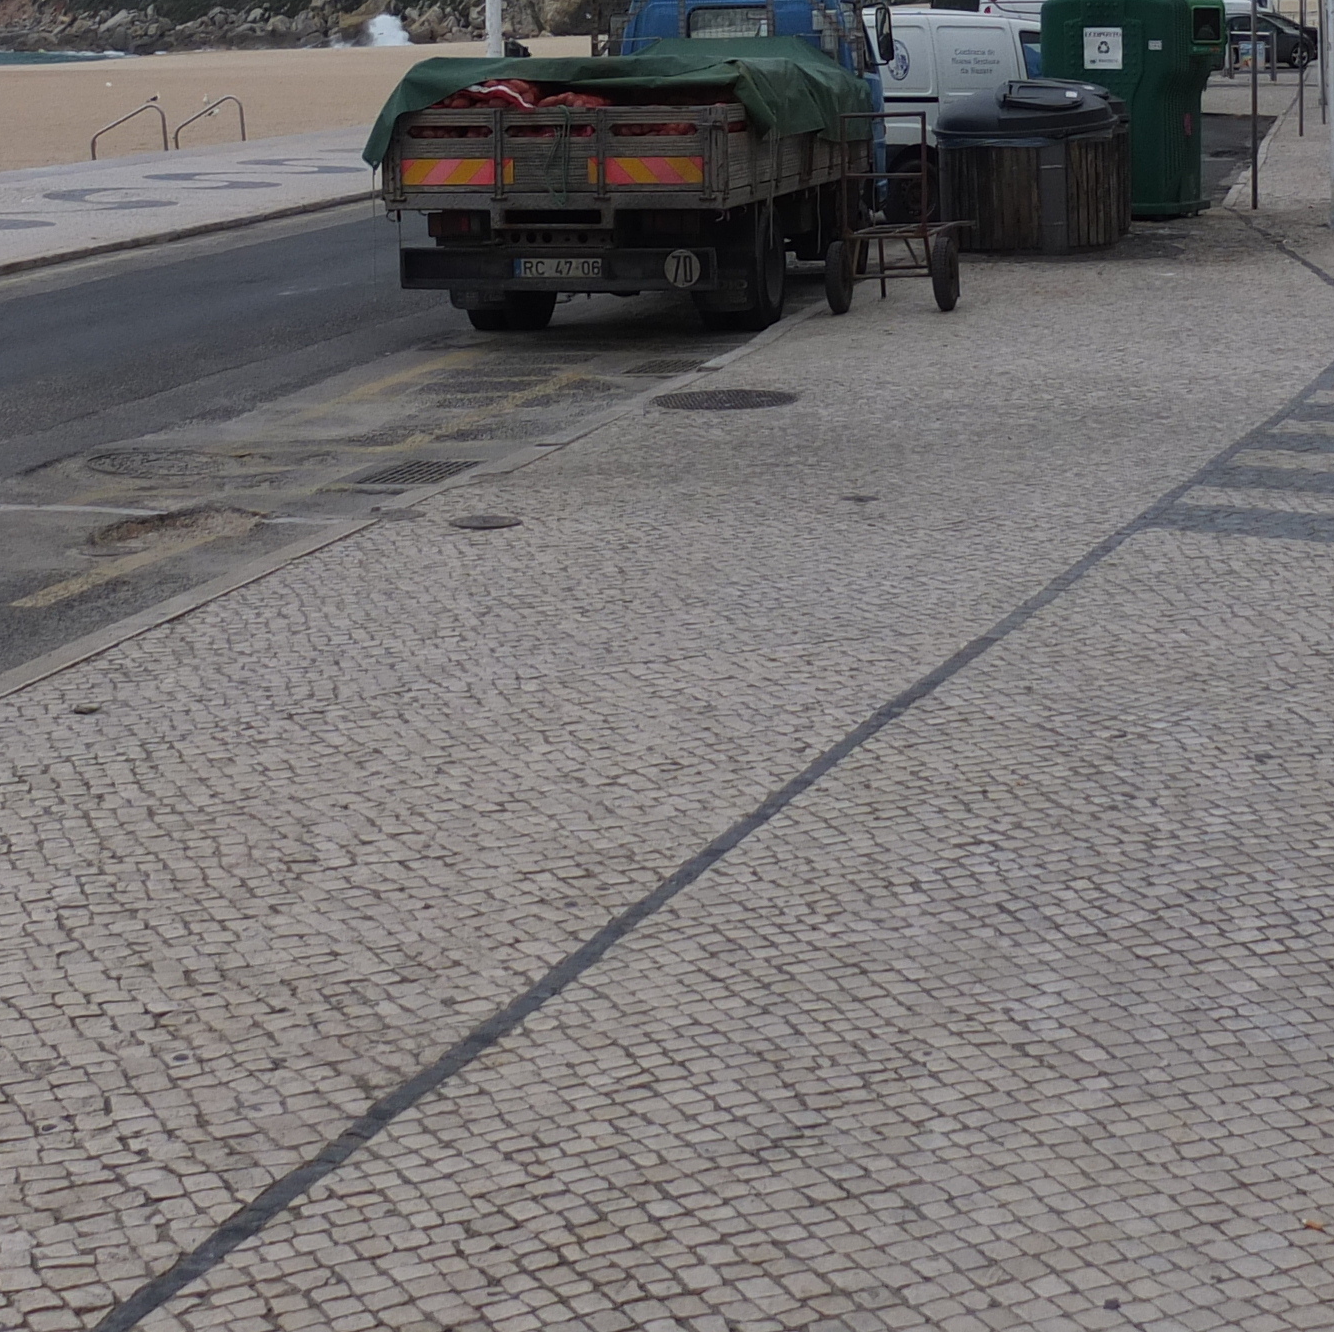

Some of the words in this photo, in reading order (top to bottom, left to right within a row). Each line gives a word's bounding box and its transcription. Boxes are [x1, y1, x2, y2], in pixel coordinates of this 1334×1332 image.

[523, 260, 545, 276] RC
[555, 260, 573, 276] 47
[581, 260, 601, 276] 06
[671, 254, 694, 284] 70
